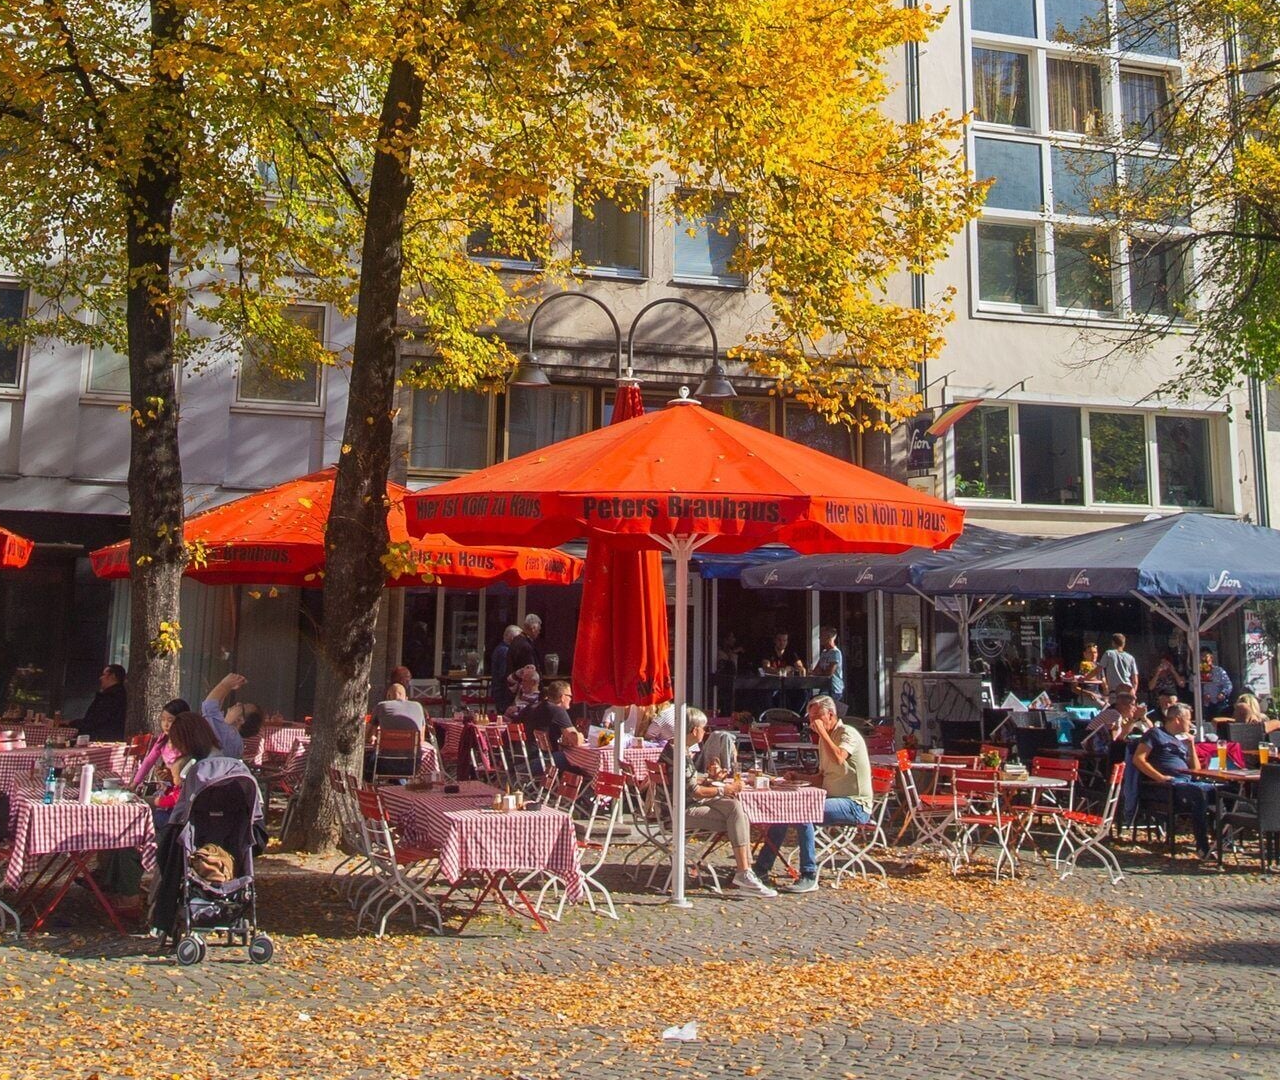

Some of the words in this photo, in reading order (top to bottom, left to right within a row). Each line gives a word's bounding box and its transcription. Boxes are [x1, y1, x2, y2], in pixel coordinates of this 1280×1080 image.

[417, 497, 439, 519] Hier
[441, 497, 459, 517] ist
[491, 496, 506, 516] zu
[583, 496, 659, 519] Peters
[668, 495, 786, 523] Brauhaus.
[826, 501, 850, 524] Hier
[854, 503, 869, 524] ist
[872, 503, 897, 526] Köln
[901, 508, 913, 528] zu
